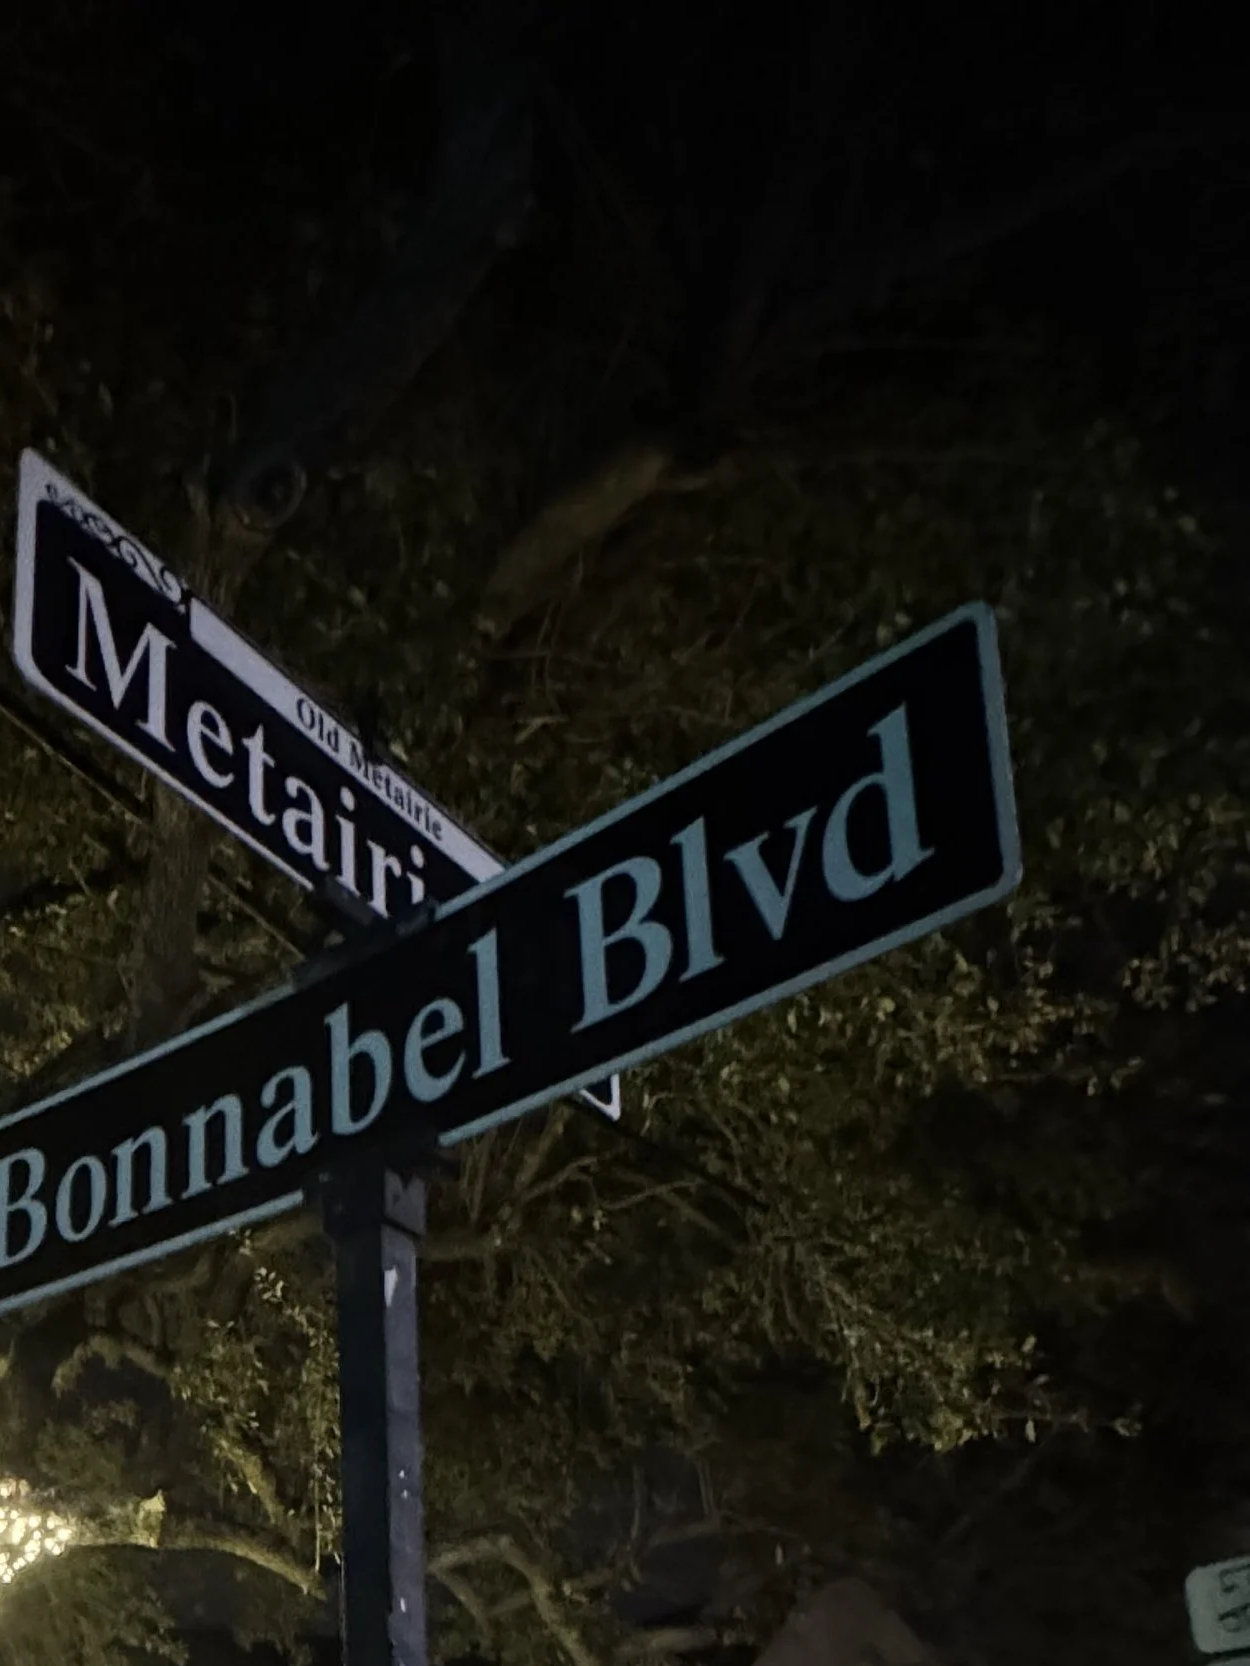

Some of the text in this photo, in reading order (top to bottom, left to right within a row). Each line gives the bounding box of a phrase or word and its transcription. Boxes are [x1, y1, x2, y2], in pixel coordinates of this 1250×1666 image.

[64, 556, 429, 919] Metairi
[295, 697, 443, 841] Old Metairie
[561, 699, 935, 1035] Blvd
